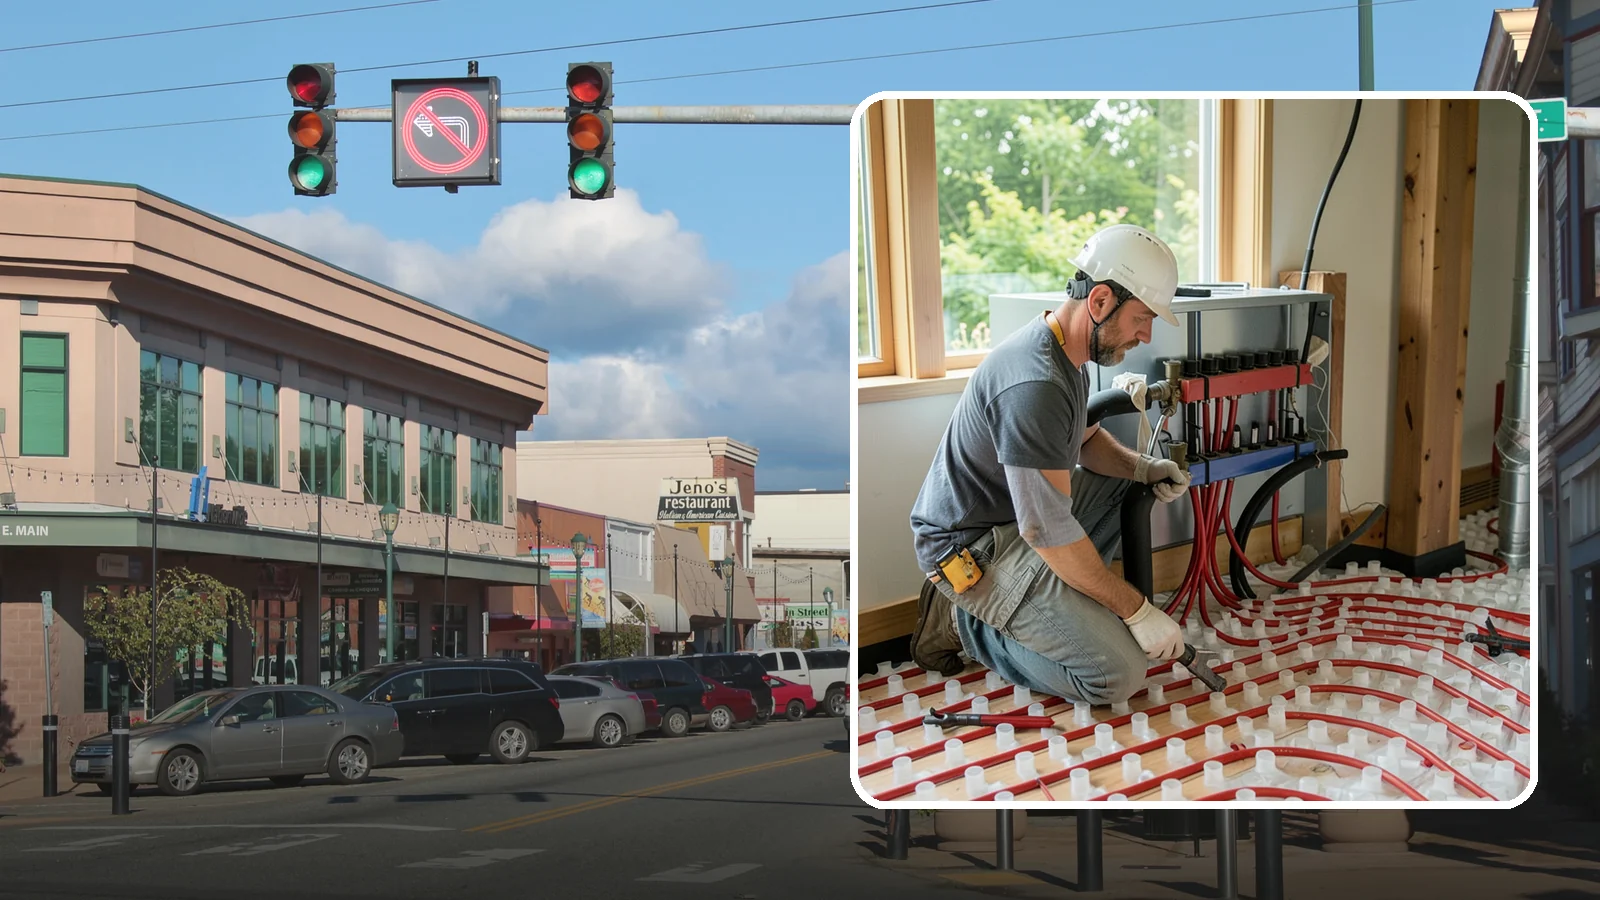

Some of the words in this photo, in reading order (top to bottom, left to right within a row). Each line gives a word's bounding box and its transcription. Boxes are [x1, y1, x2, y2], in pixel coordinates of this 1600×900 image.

[670, 480, 727, 494] Jeno's
[665, 497, 730, 508] restaurant
[659, 510, 681, 519] Italian
[686, 510, 714, 519] American
[715, 510, 737, 519] Cuisine
[2, 525, 13, 536] E.
[15, 525, 49, 536] MAIN
[786, 608, 794, 617] in
[798, 608, 828, 617] Street
[790, 619, 823, 627] lass
